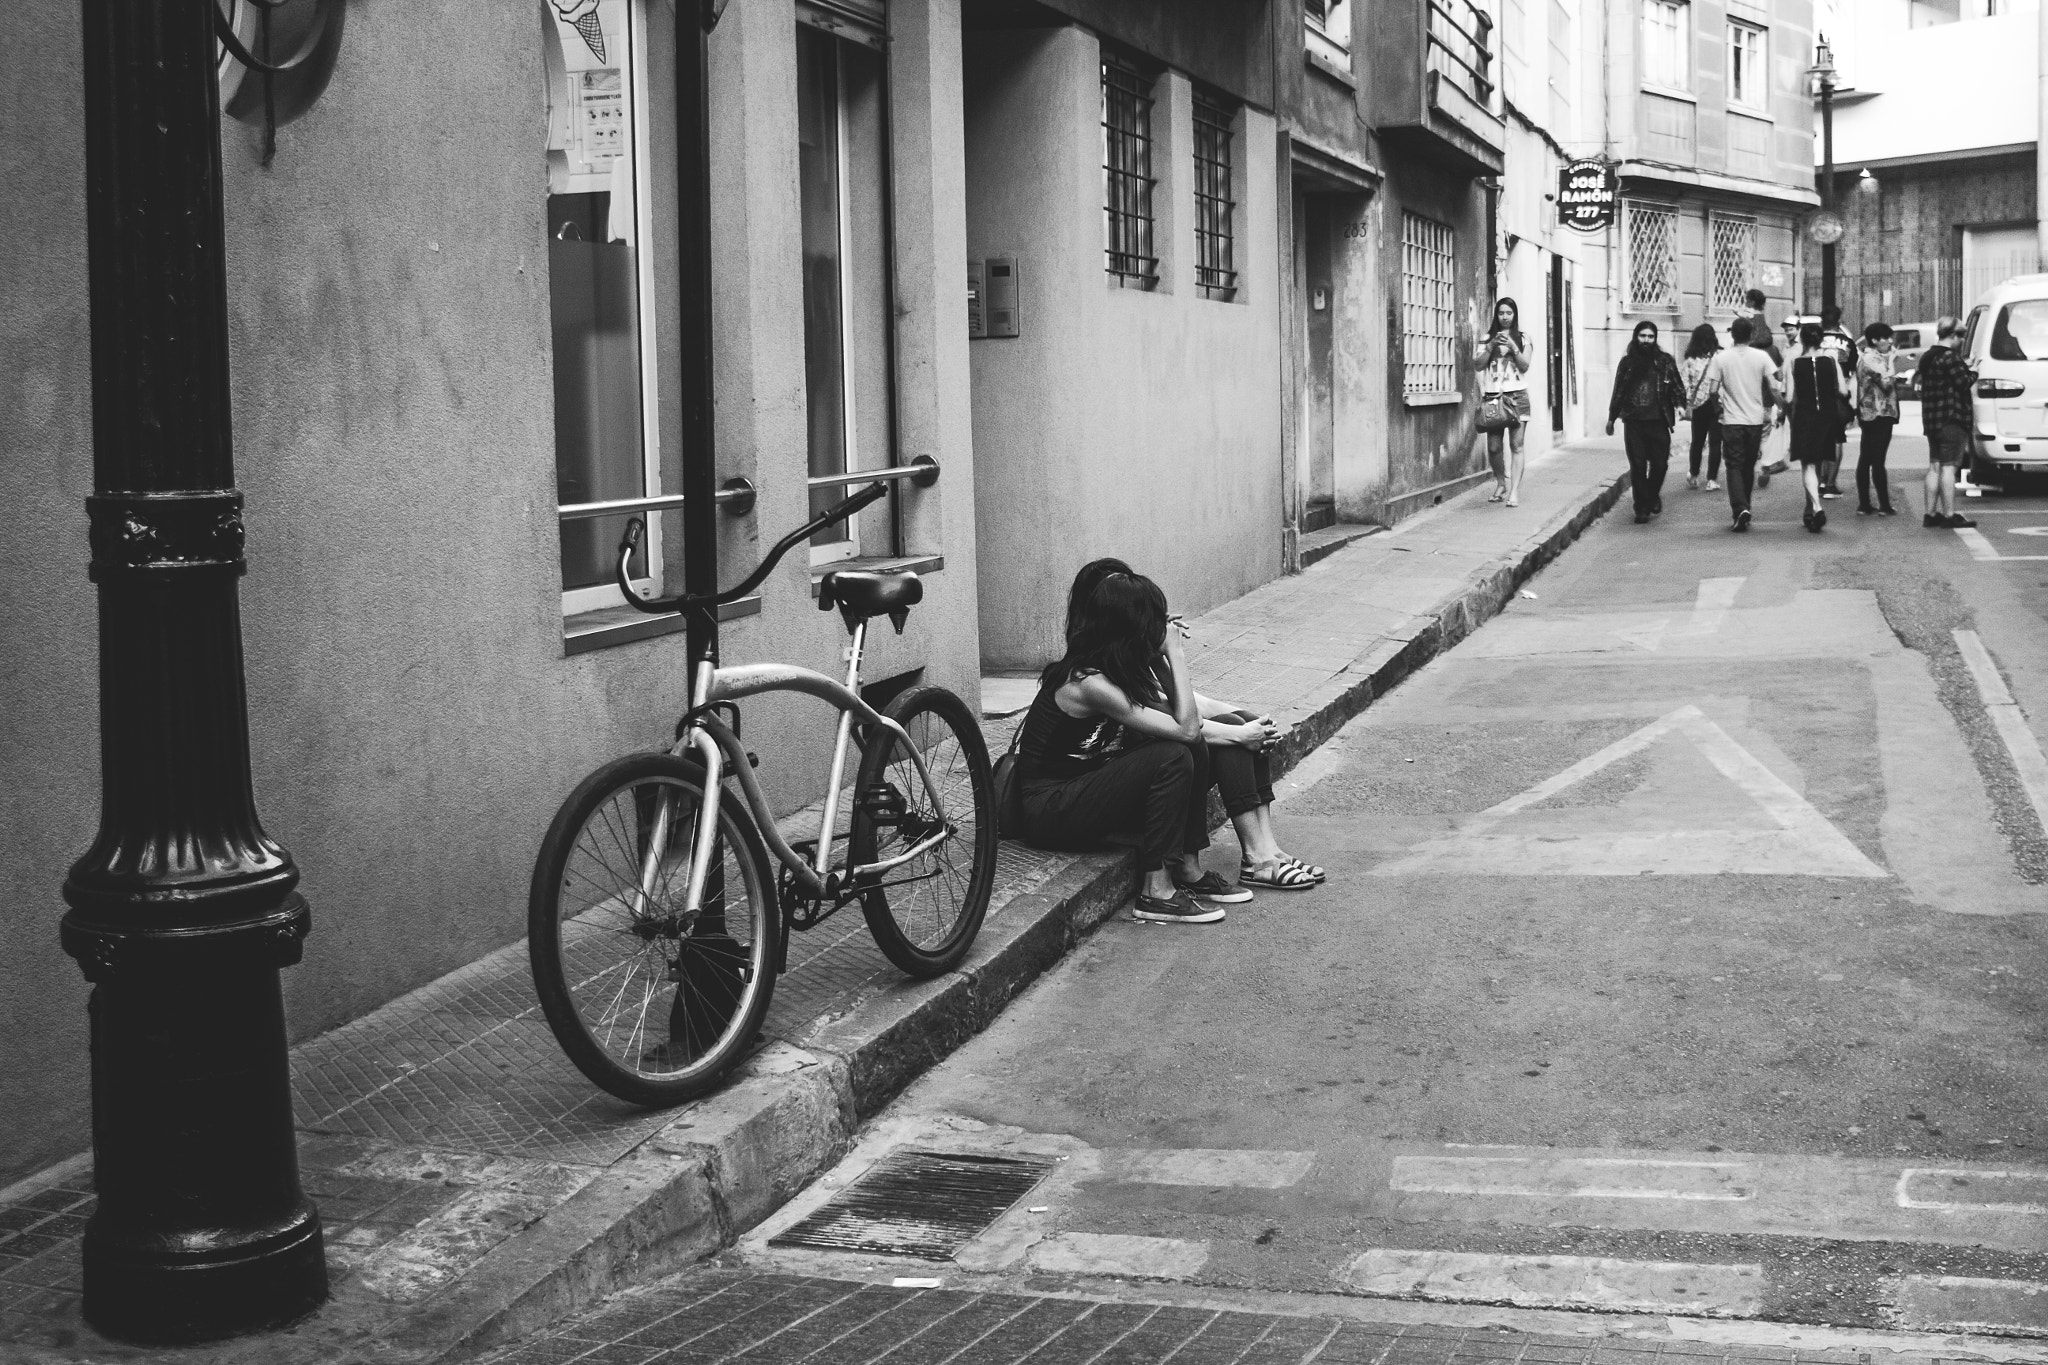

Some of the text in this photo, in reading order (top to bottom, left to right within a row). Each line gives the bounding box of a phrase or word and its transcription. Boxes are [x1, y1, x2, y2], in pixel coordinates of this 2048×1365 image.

[1569, 174, 1605, 189] JOSÉ
[1561, 188, 1613, 203] RAMÓN
[1576, 205, 1600, 218] 277
[1343, 222, 1367, 239] 283
